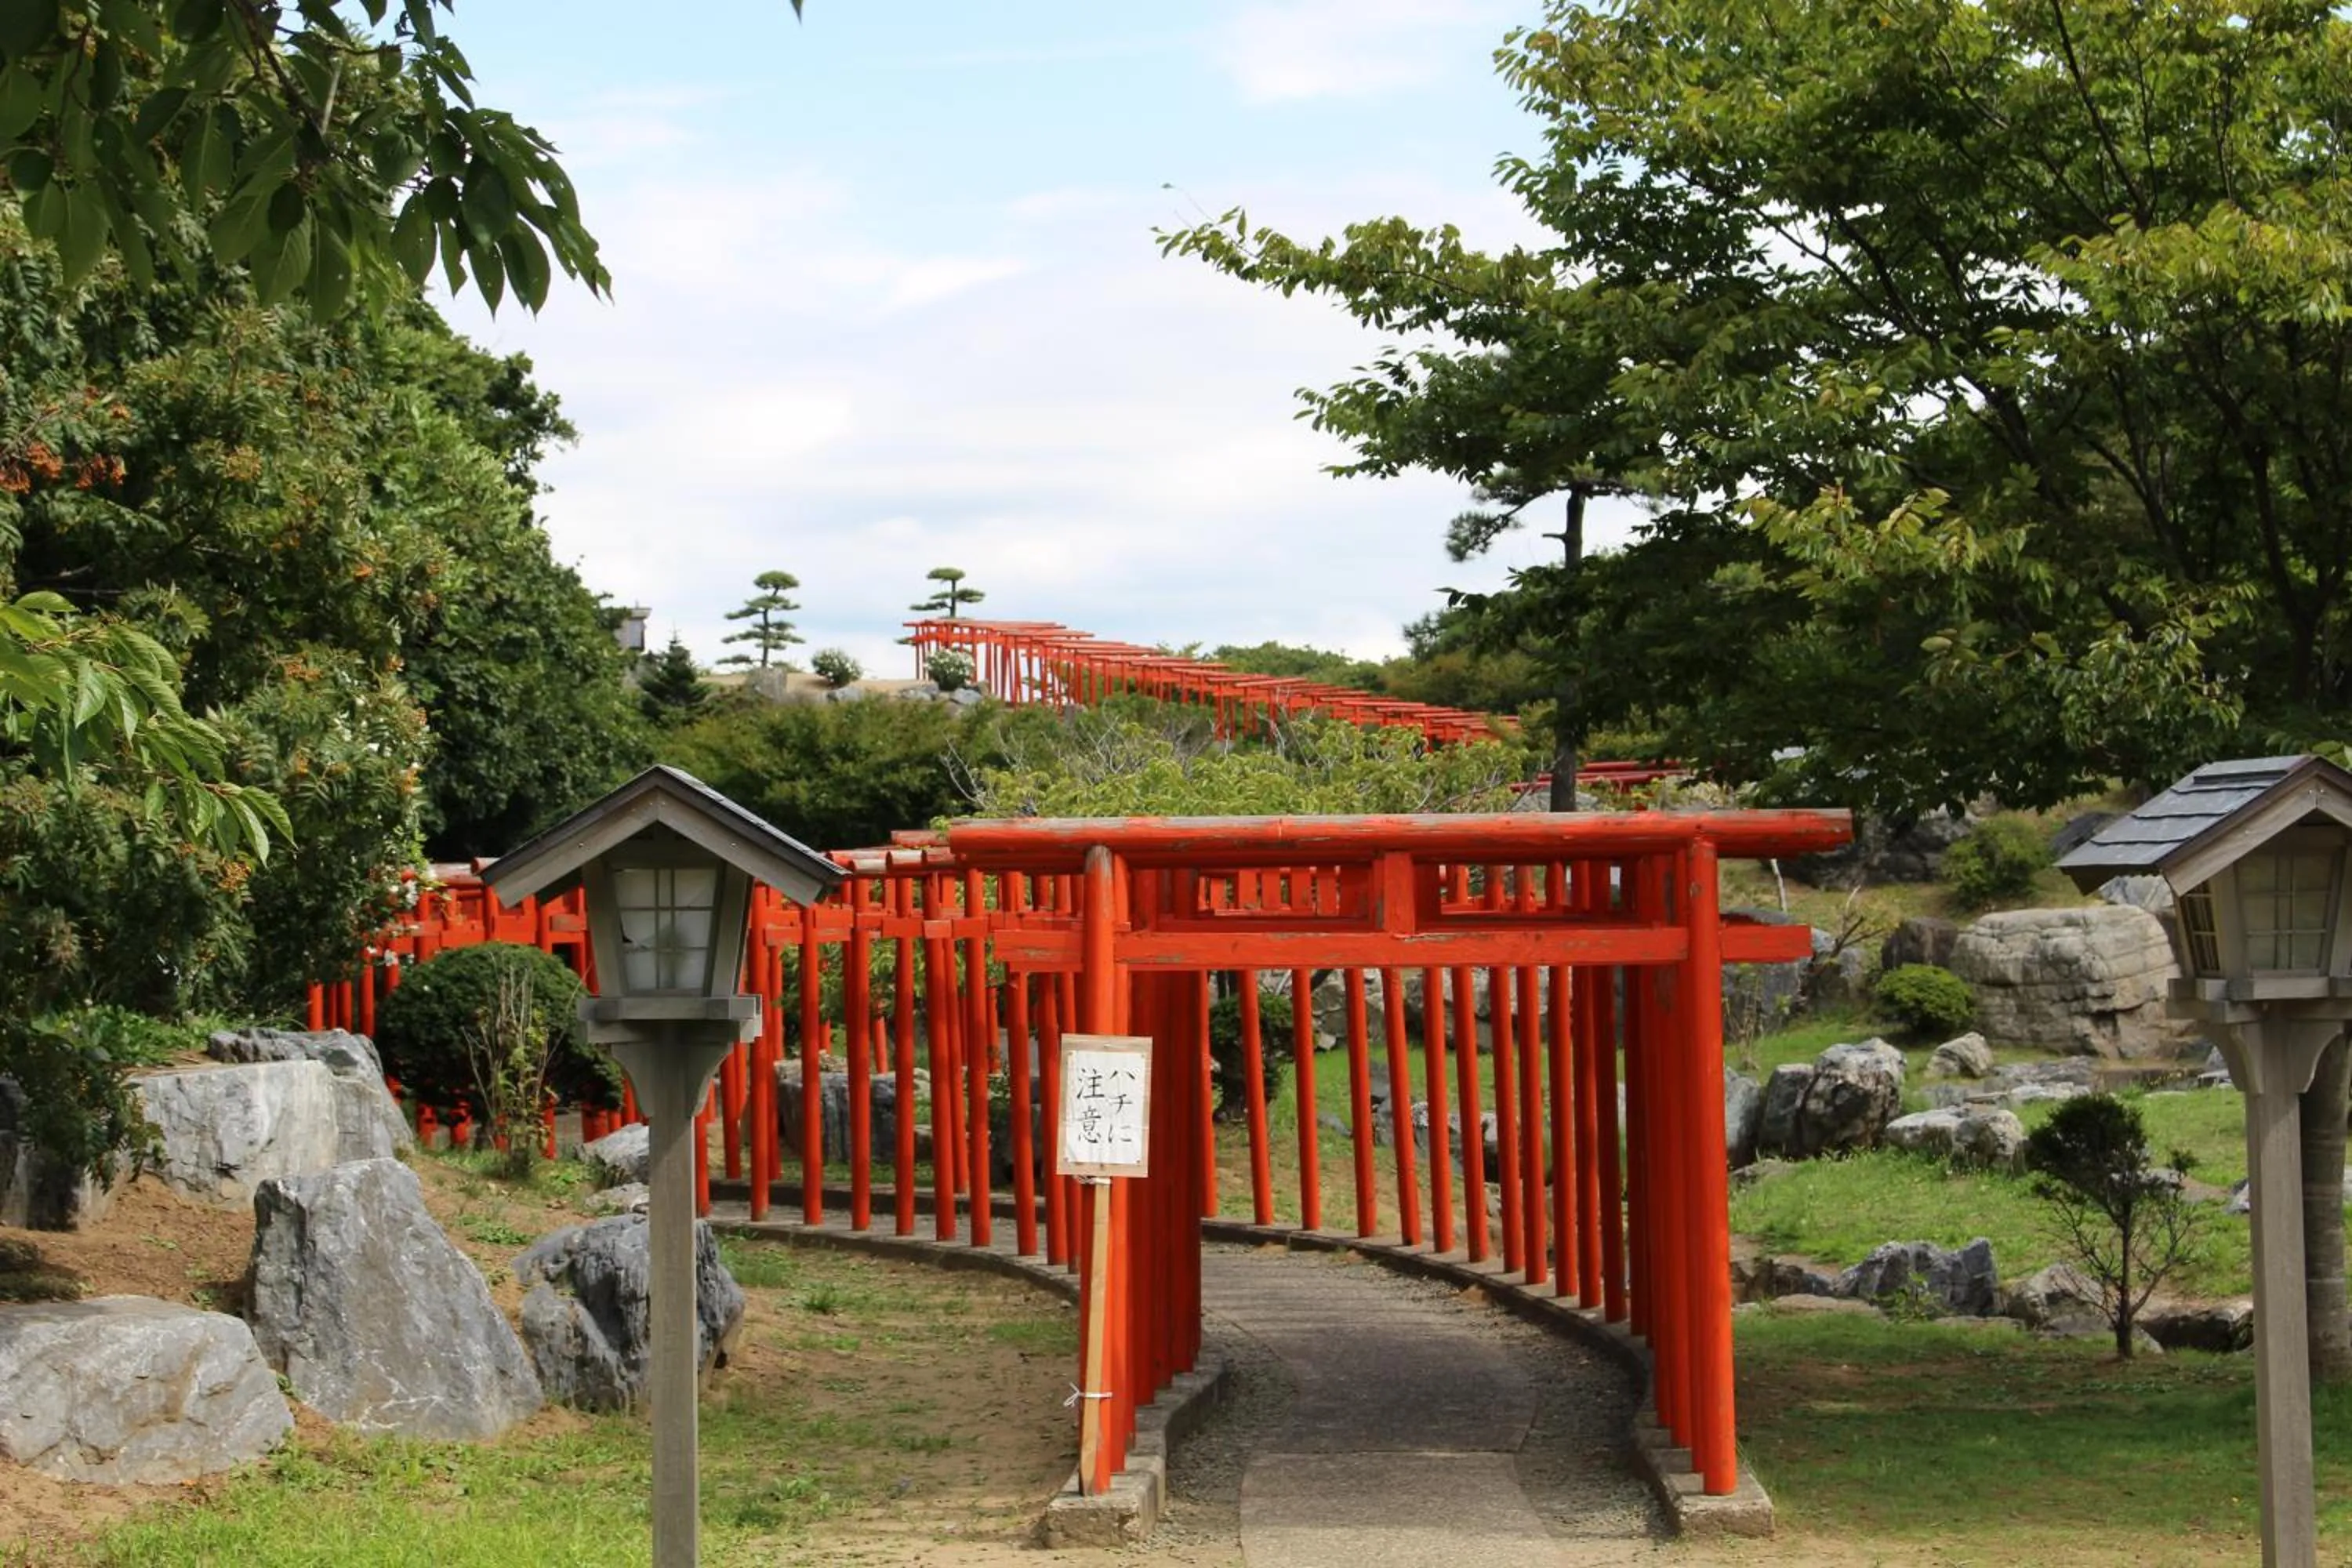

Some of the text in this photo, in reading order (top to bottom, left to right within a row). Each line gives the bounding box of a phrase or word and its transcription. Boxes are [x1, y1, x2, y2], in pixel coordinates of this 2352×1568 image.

[1076, 1068, 1105, 1144] 注意
[1107, 1070, 1136, 1143] ハチに
